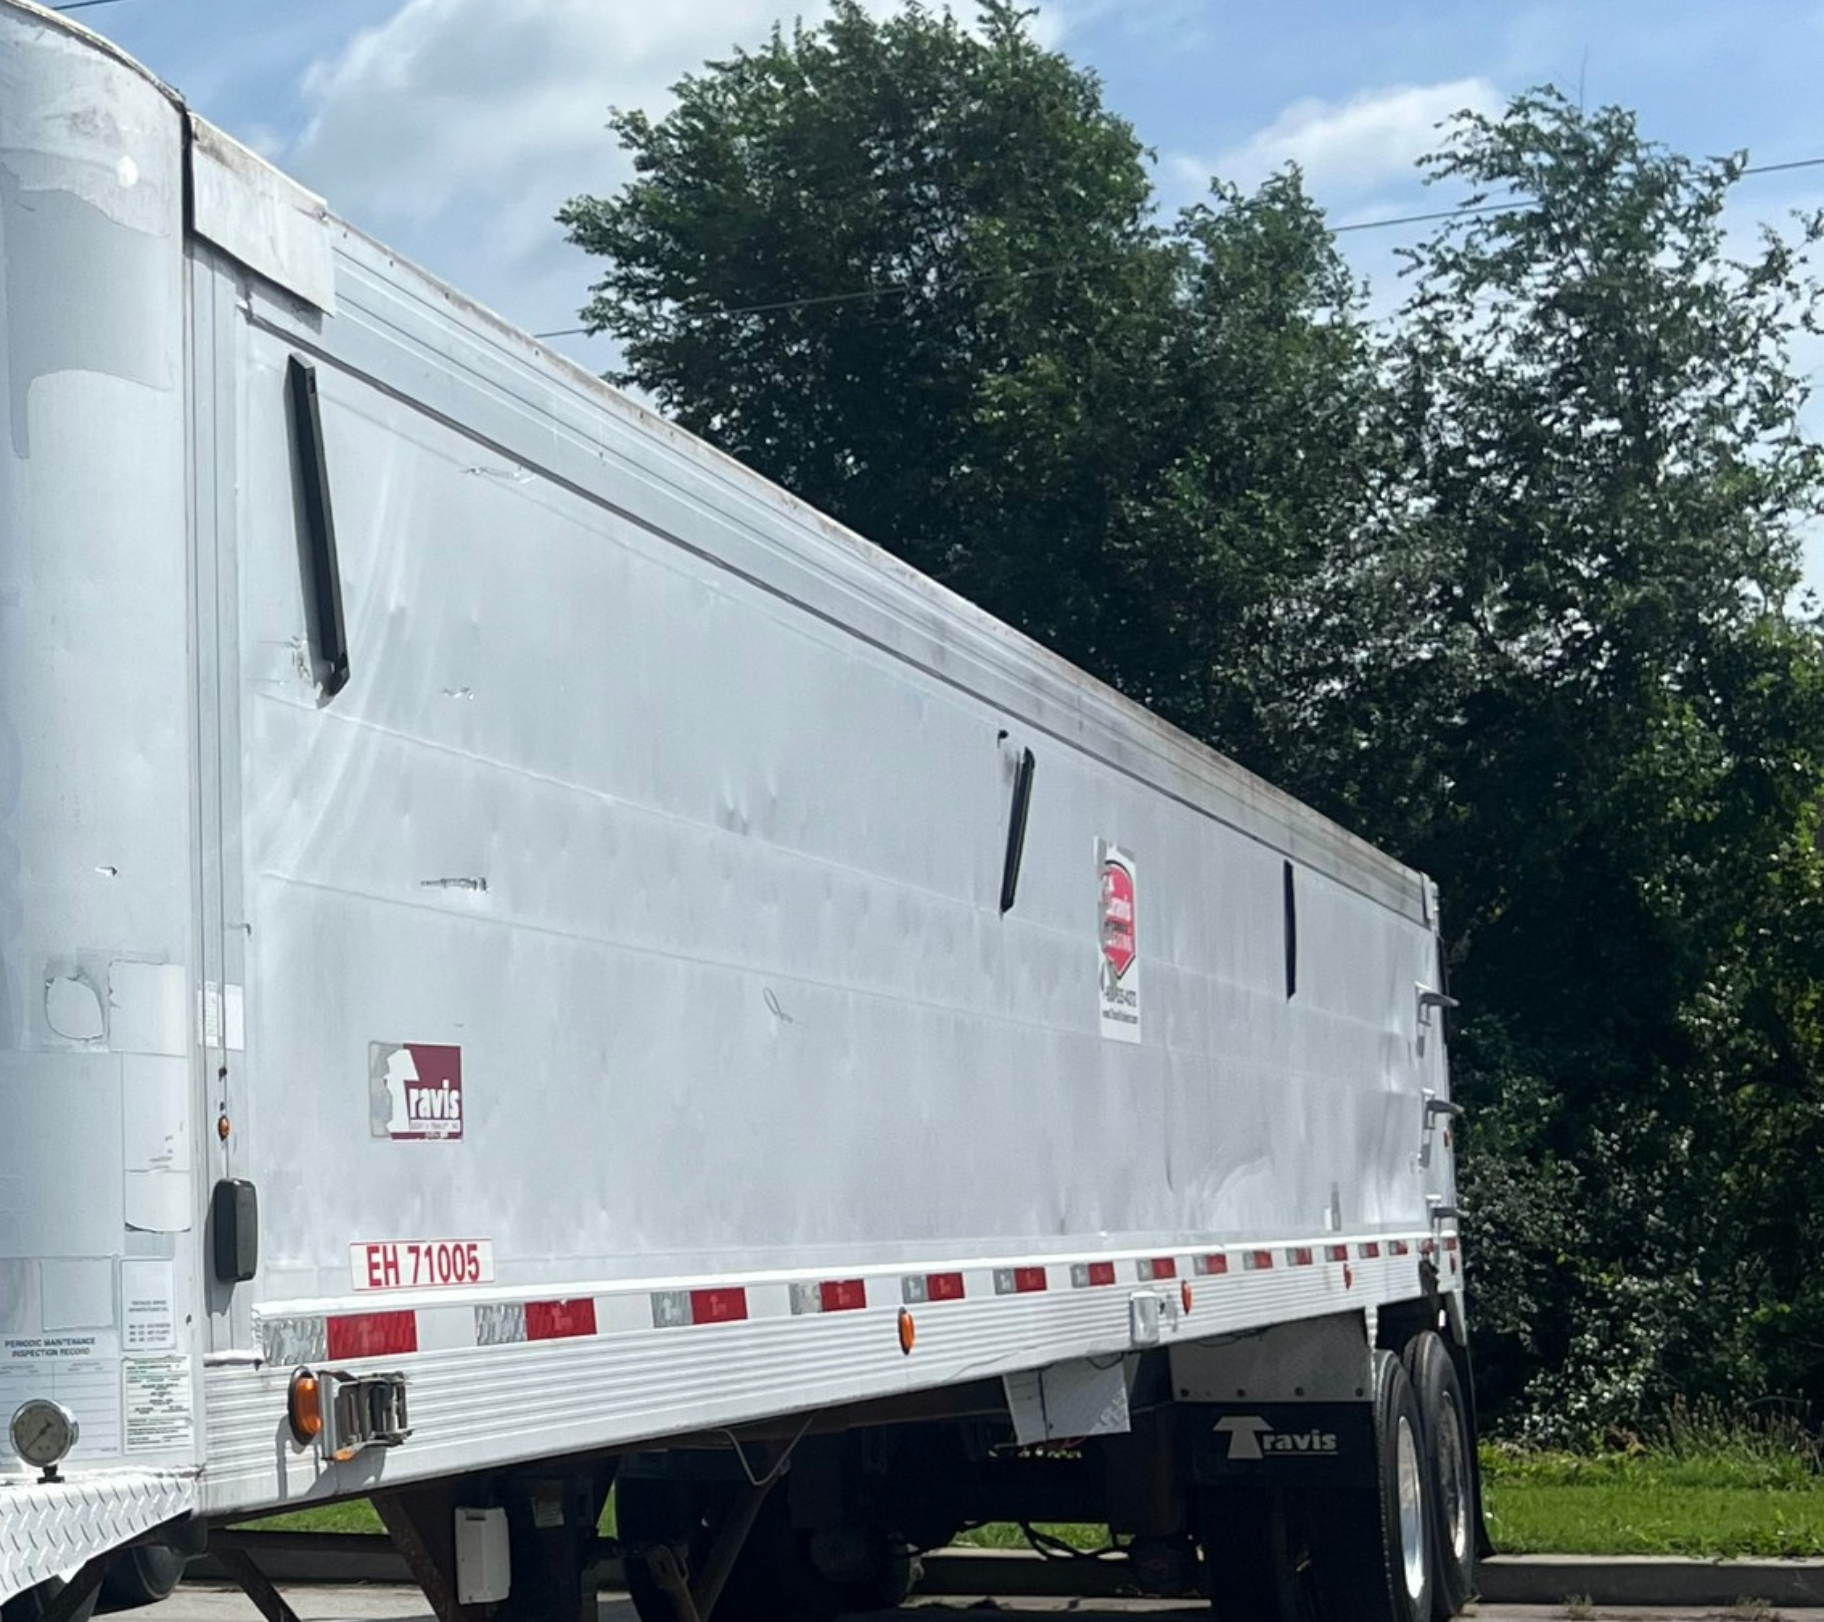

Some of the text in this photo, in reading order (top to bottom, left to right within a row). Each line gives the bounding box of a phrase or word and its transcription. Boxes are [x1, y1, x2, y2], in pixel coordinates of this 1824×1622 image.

[366, 1243, 480, 1287] EH 71005
[1212, 1415, 1338, 1459] Travis
